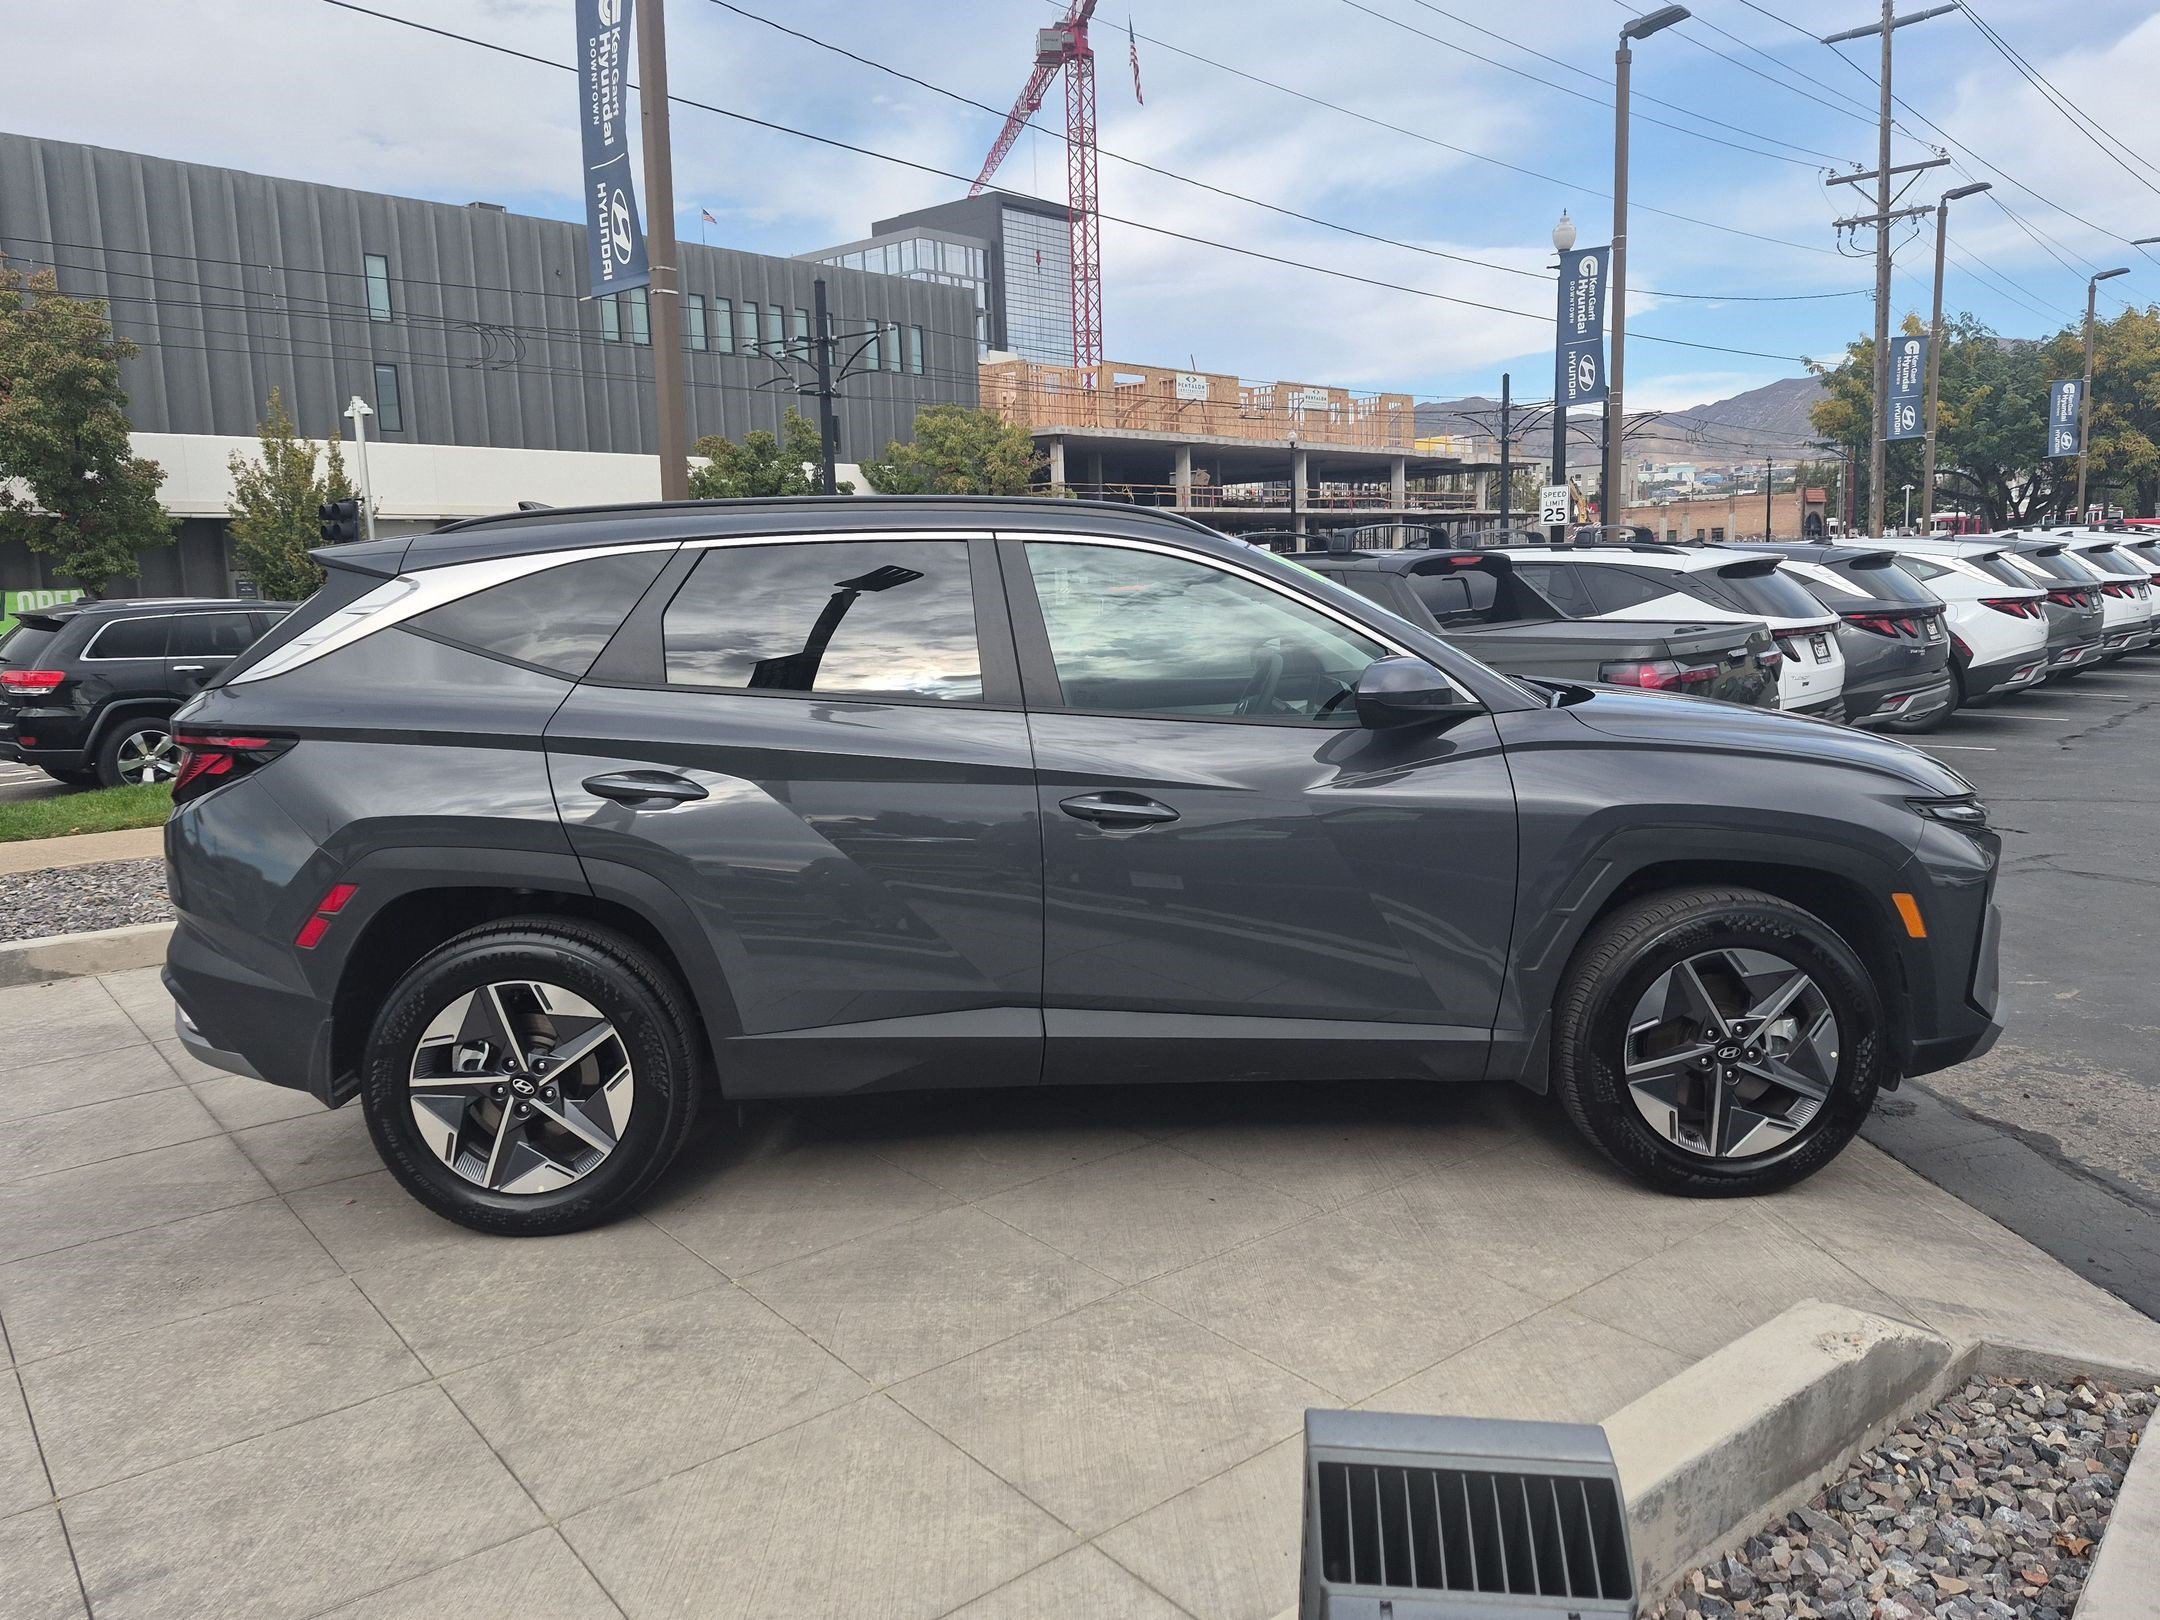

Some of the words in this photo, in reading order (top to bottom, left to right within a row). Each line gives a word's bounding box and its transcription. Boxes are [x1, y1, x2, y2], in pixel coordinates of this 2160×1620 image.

[611, 27, 621, 66] Ken
[589, 37, 600, 125] DOWNTOWN
[598, 31, 614, 146] Hyundai
[611, 68, 620, 117] Garff
[597, 182, 613, 281] HYUNDAI
[1576, 278, 1588, 334] Hyundai
[1588, 277, 1598, 296] Ken
[1588, 297, 1597, 321] Garff
[1568, 351, 1576, 400] HYUNDAI
[1902, 355, 1911, 393] Hyundai
[1894, 402, 1902, 436] HYUNDAI
[1543, 491, 1567, 499] SPEED
[1543, 508, 1566, 522] 25
